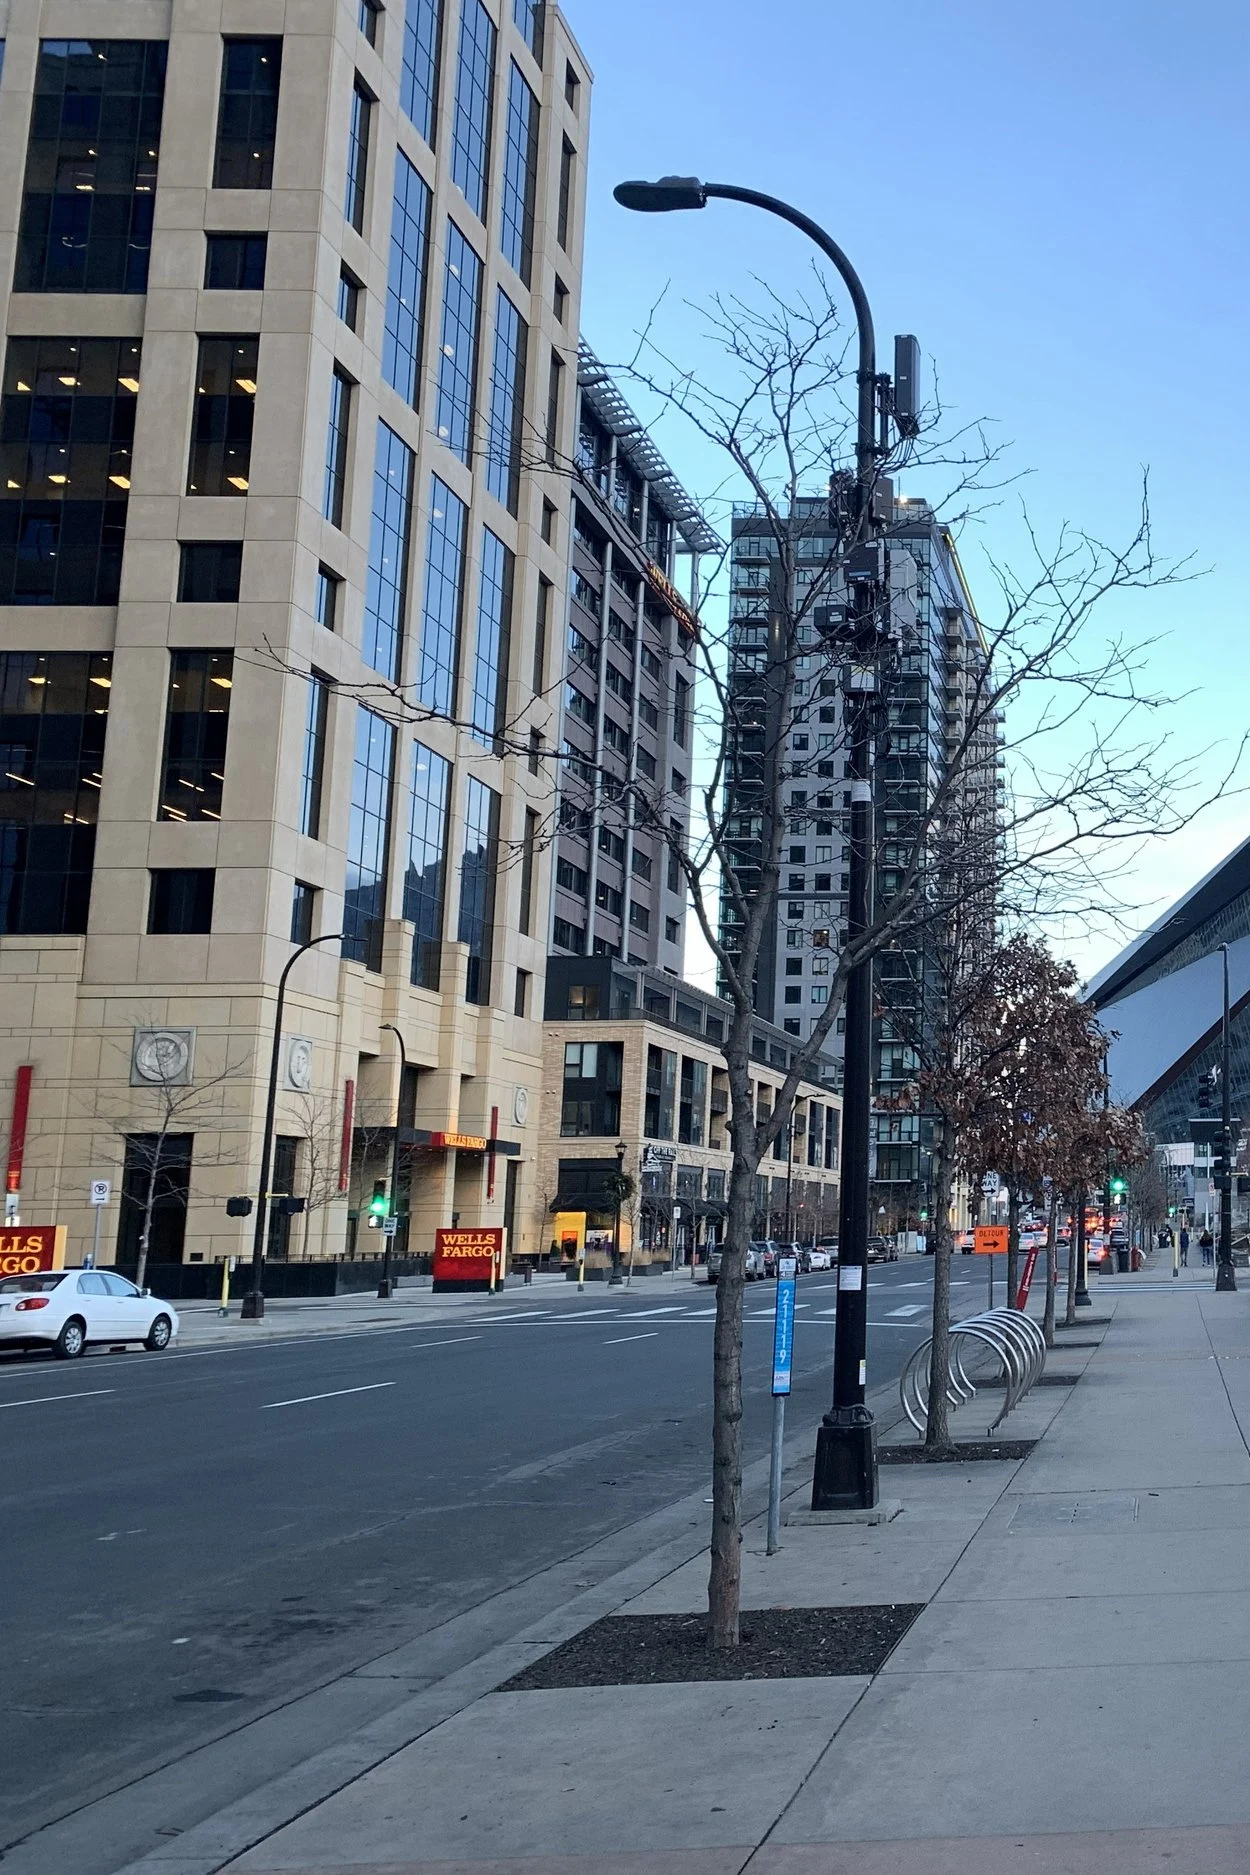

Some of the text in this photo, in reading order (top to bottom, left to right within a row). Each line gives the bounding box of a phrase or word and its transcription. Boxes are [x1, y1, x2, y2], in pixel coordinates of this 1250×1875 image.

[444, 1133, 487, 1149] WELLS FARGO
[442, 1234, 496, 1245] WELLS
[979, 1230, 1004, 1238] DETOUR
[442, 1246, 495, 1257] FARGO
[0, 1257, 40, 1274] GO
